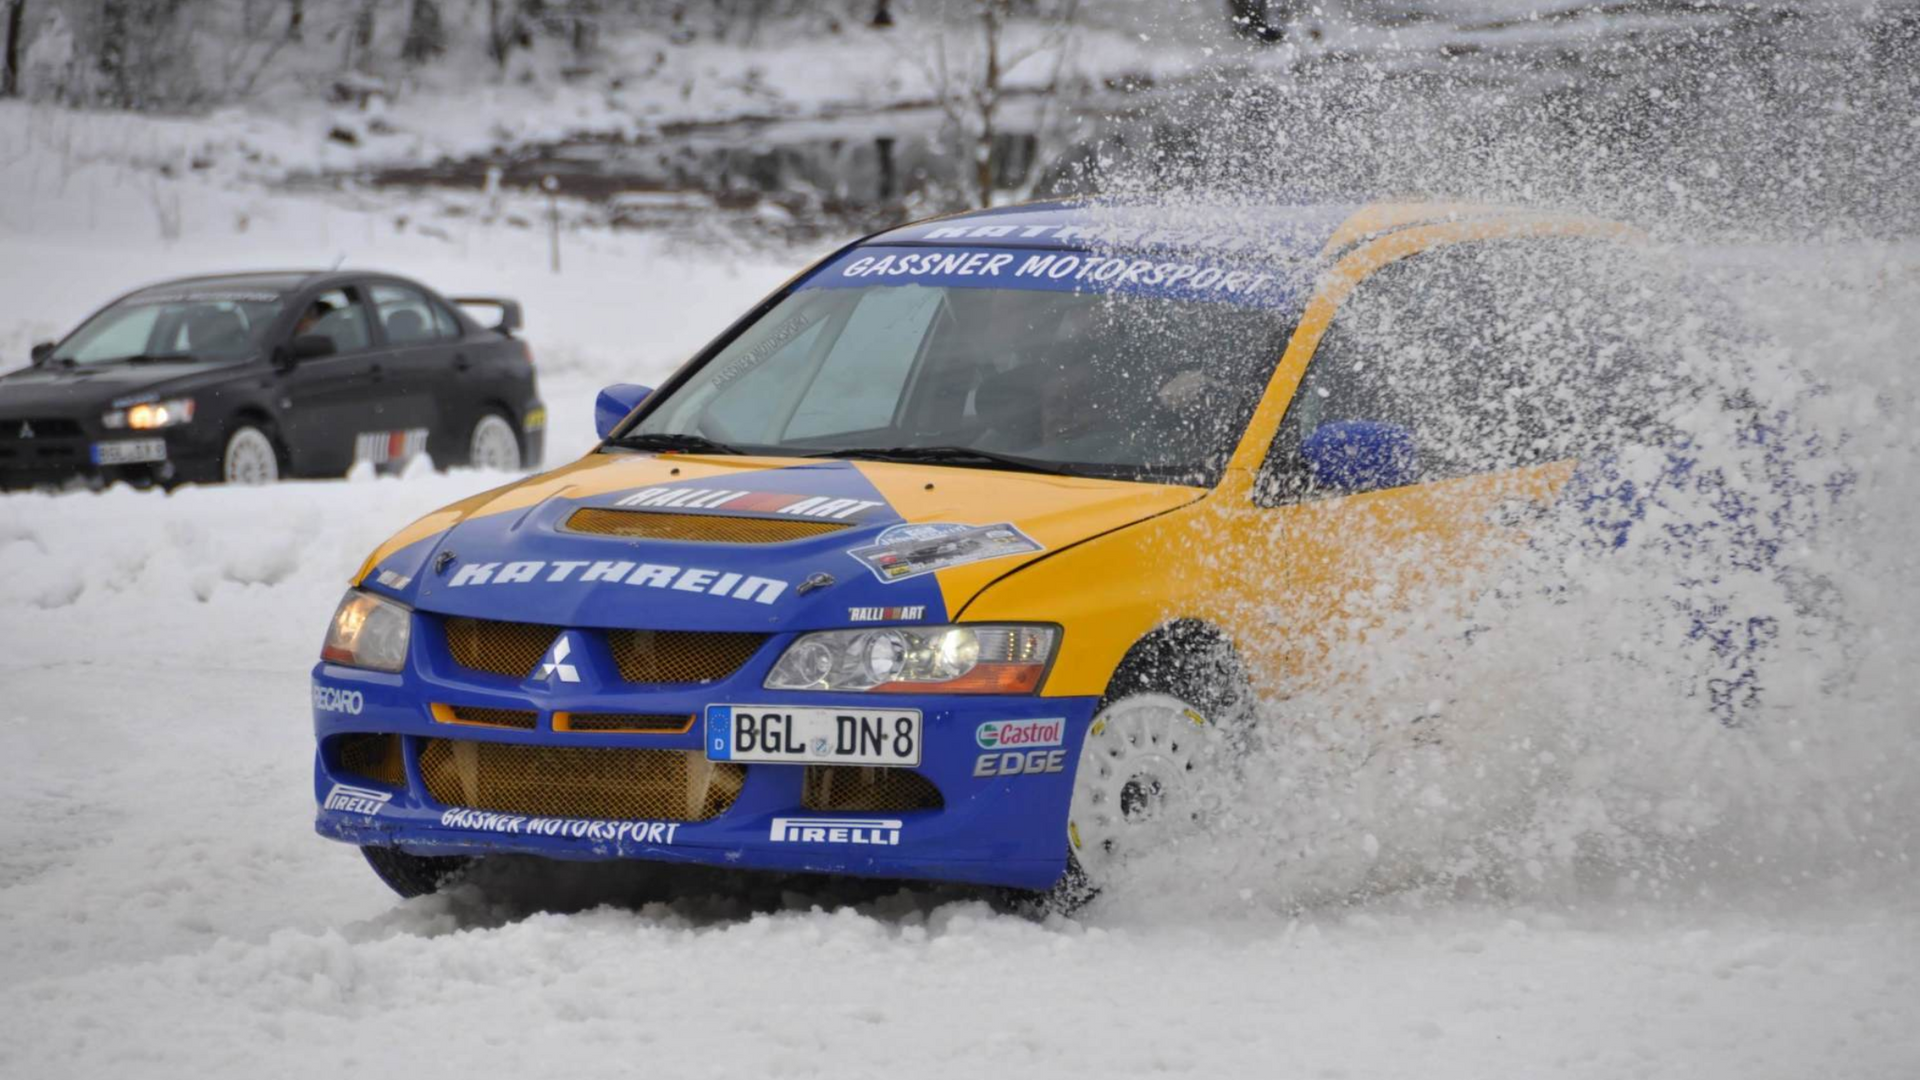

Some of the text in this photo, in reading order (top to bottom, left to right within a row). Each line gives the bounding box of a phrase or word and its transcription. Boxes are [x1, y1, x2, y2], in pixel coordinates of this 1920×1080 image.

[926, 224, 1252, 249] KATH
[843, 252, 1275, 296] GASSNER MOTORSPORT
[447, 560, 789, 606] KATHREIN
[714, 713, 914, 758] D BGL DN 8
[1000, 719, 1060, 745] Castrol
[973, 749, 1067, 777] EDGE
[324, 782, 393, 816] PIRELLI
[440, 807, 681, 845] GASSNER MOTORSPORT
[769, 817, 903, 846] PIRELLI
